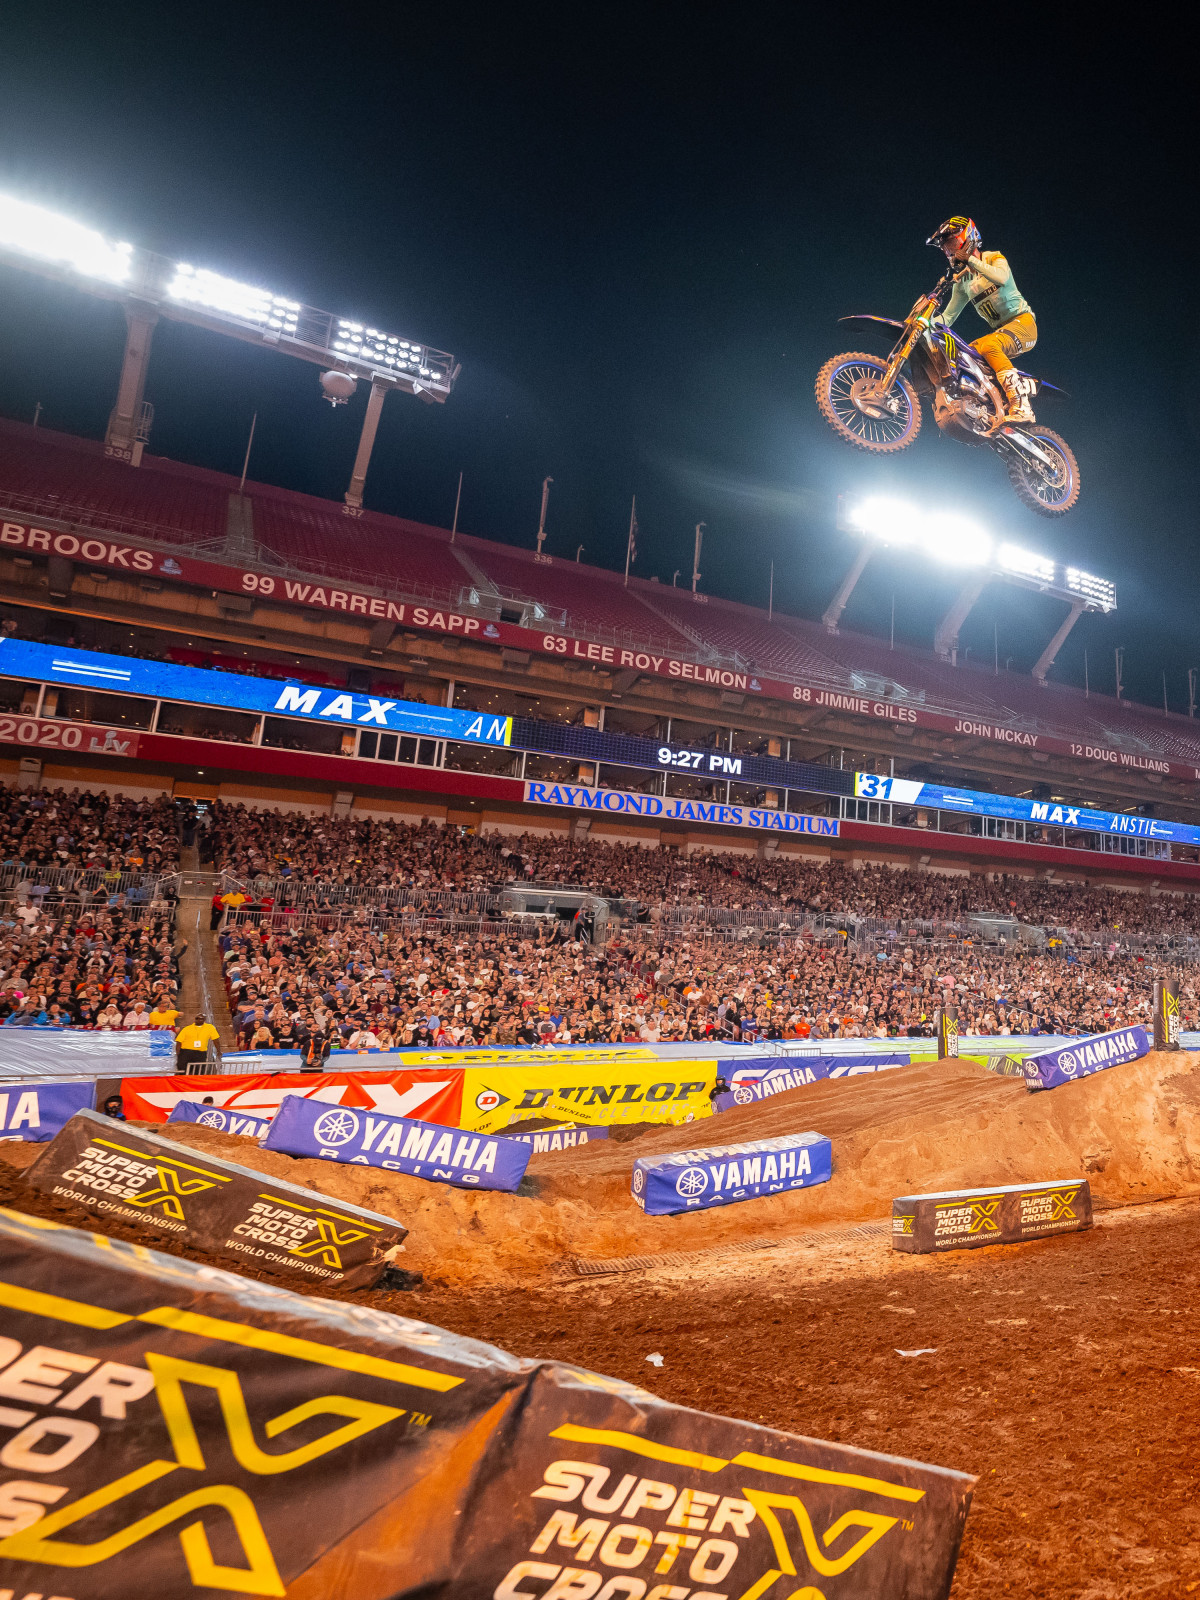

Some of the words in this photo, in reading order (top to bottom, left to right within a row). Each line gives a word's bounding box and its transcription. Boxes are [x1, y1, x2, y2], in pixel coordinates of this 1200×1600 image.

[104, 446, 132, 461] 338
[342, 505, 365, 518] 337
[1, 522, 154, 571] BROOKS
[534, 552, 553, 565] 336
[242, 573, 275, 594] 99
[284, 580, 405, 621] WARREN
[412, 608, 480, 634] SAPP
[543, 635, 567, 653] 63
[574, 641, 614, 663] LEE
[620, 650, 664, 672] ROY
[668, 660, 748, 690] SELMON
[274, 686, 398, 725] MAX
[792, 686, 812, 702] 88
[815, 691, 869, 714] JIMMIE
[873, 702, 918, 723] GILES
[0, 719, 82, 748] 2020
[955, 719, 991, 738] JOHN
[994, 727, 1038, 747] MCKAY
[657, 747, 704, 769] 9:27
[709, 754, 742, 775] PM
[1070, 743, 1083, 756] 12
[1085, 746, 1118, 763] DOUG
[1120, 753, 1170, 774] WILLIAMS
[528, 782, 663, 815] RAYMOND
[666, 800, 743, 826] JAMES
[749, 810, 839, 837] STADIUM
[859, 773, 894, 800] 31
[1030, 802, 1080, 826] MAX
[1110, 815, 1158, 836] ANSTIE
[1075, 1031, 1138, 1068] YAMAHA
[1069, 1052, 1138, 1080] RACING
[514, 1081, 706, 1110] DUNLOP
[751, 1066, 817, 1100] YAMAHA
[557, 1104, 592, 1120] DUNLOP
[361, 1116, 499, 1174] YAMAHA
[76, 1158, 147, 1189] MOTO
[79, 1146, 159, 1179] SUPER
[319, 1148, 481, 1184] RACING
[709, 1149, 812, 1192] YAMAHA
[61, 1168, 141, 1200] CROSS
[687, 1179, 804, 1206] RACING
[52, 1185, 98, 1210] WORLD
[98, 1200, 187, 1232] CHAMPIONSHIP
[248, 1202, 319, 1231] SUPER
[935, 1207, 973, 1220] SUPER
[1020, 1197, 1053, 1208] SUPER
[1022, 1205, 1052, 1215] MOTO
[244, 1213, 309, 1240] MOTO
[934, 1223, 972, 1236] CROSS
[937, 1216, 972, 1227] MOTO
[1021, 1212, 1053, 1224] CROSS
[1021, 1225, 1041, 1234] WORLD
[1041, 1219, 1081, 1231] CHAMPIONSHIP
[233, 1222, 303, 1251] CROSS
[935, 1237, 957, 1247] WORLD
[957, 1231, 1002, 1244] CHAMPIONSHIP
[224, 1239, 264, 1259] WORLD
[264, 1252, 344, 1281] CHAMPIONSHIP
[530, 1459, 757, 1539] SUPER
[529, 1509, 739, 1586] MOTO
[493, 1561, 729, 1600] CRO
